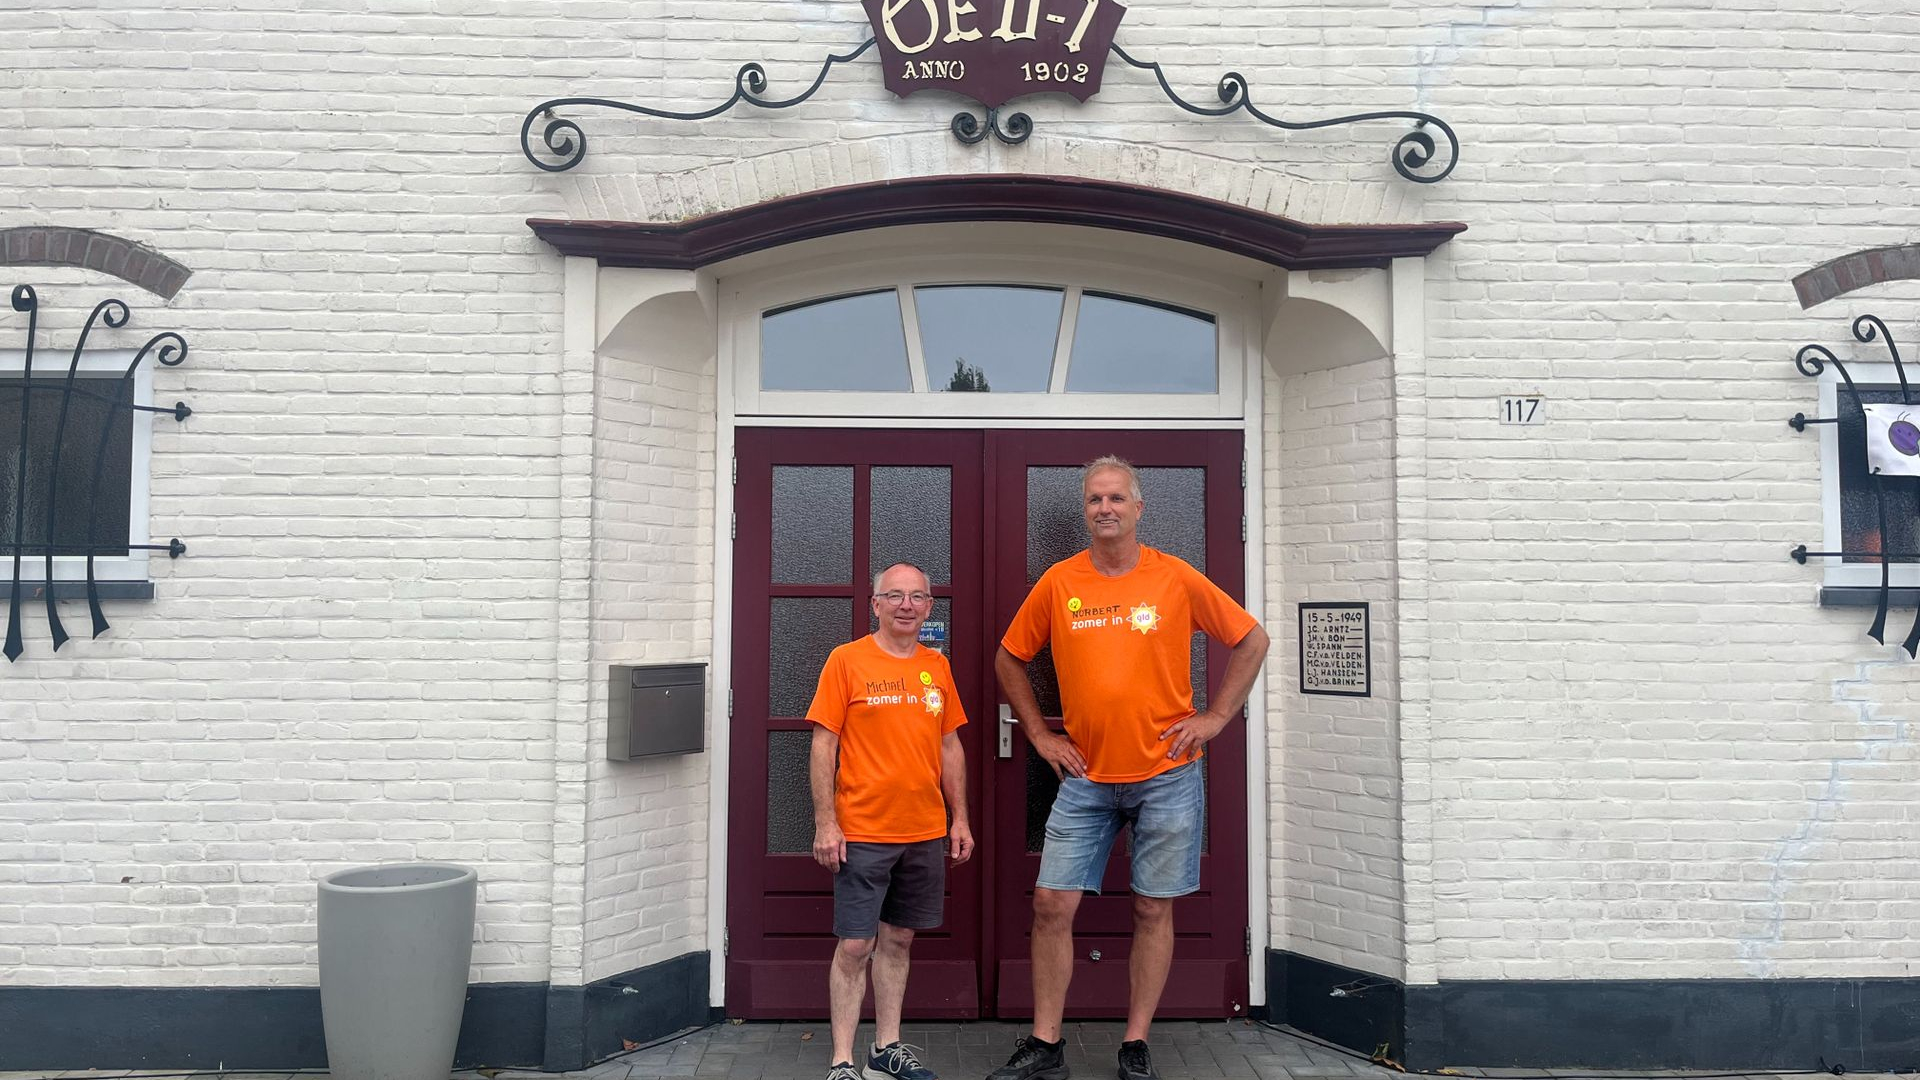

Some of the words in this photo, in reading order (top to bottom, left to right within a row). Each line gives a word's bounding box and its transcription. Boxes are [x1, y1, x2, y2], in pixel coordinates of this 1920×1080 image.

[902, 60, 965, 80] ANNO
[1020, 62, 1089, 83] 1902
[1505, 399, 1540, 422] 117
[1072, 605, 1120, 619] NORBERT
[1071, 617, 1108, 630] zomer
[1111, 615, 1123, 625] in
[1328, 634, 1345, 642] BON
[1332, 678, 1356, 686] BRINK
[866, 694, 902, 706] zomer
[907, 692, 918, 704] in
